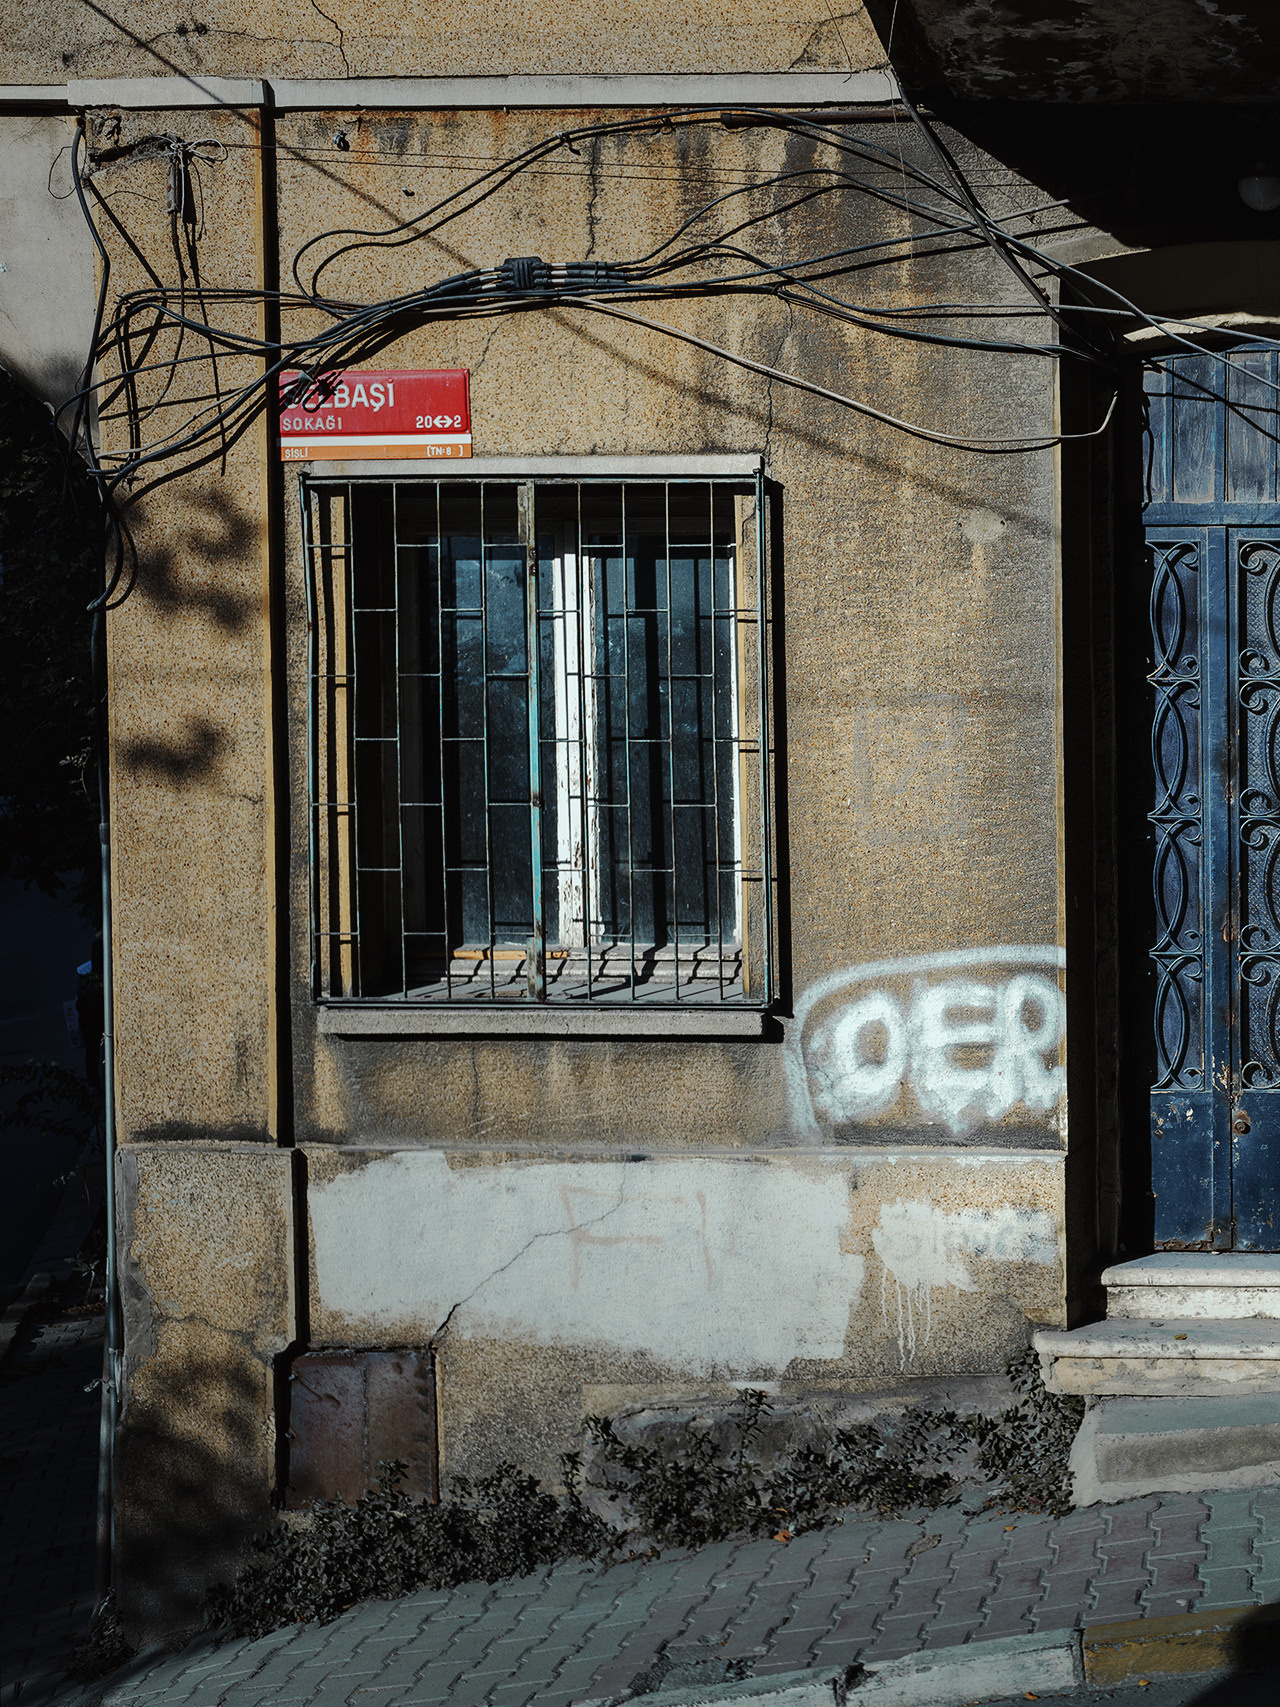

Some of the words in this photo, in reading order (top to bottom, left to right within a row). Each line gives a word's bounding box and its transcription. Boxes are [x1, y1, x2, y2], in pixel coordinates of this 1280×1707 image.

[282, 416, 342, 431] SOKAĞI
[415, 415, 432, 429] 20
[453, 415, 462, 428] 2
